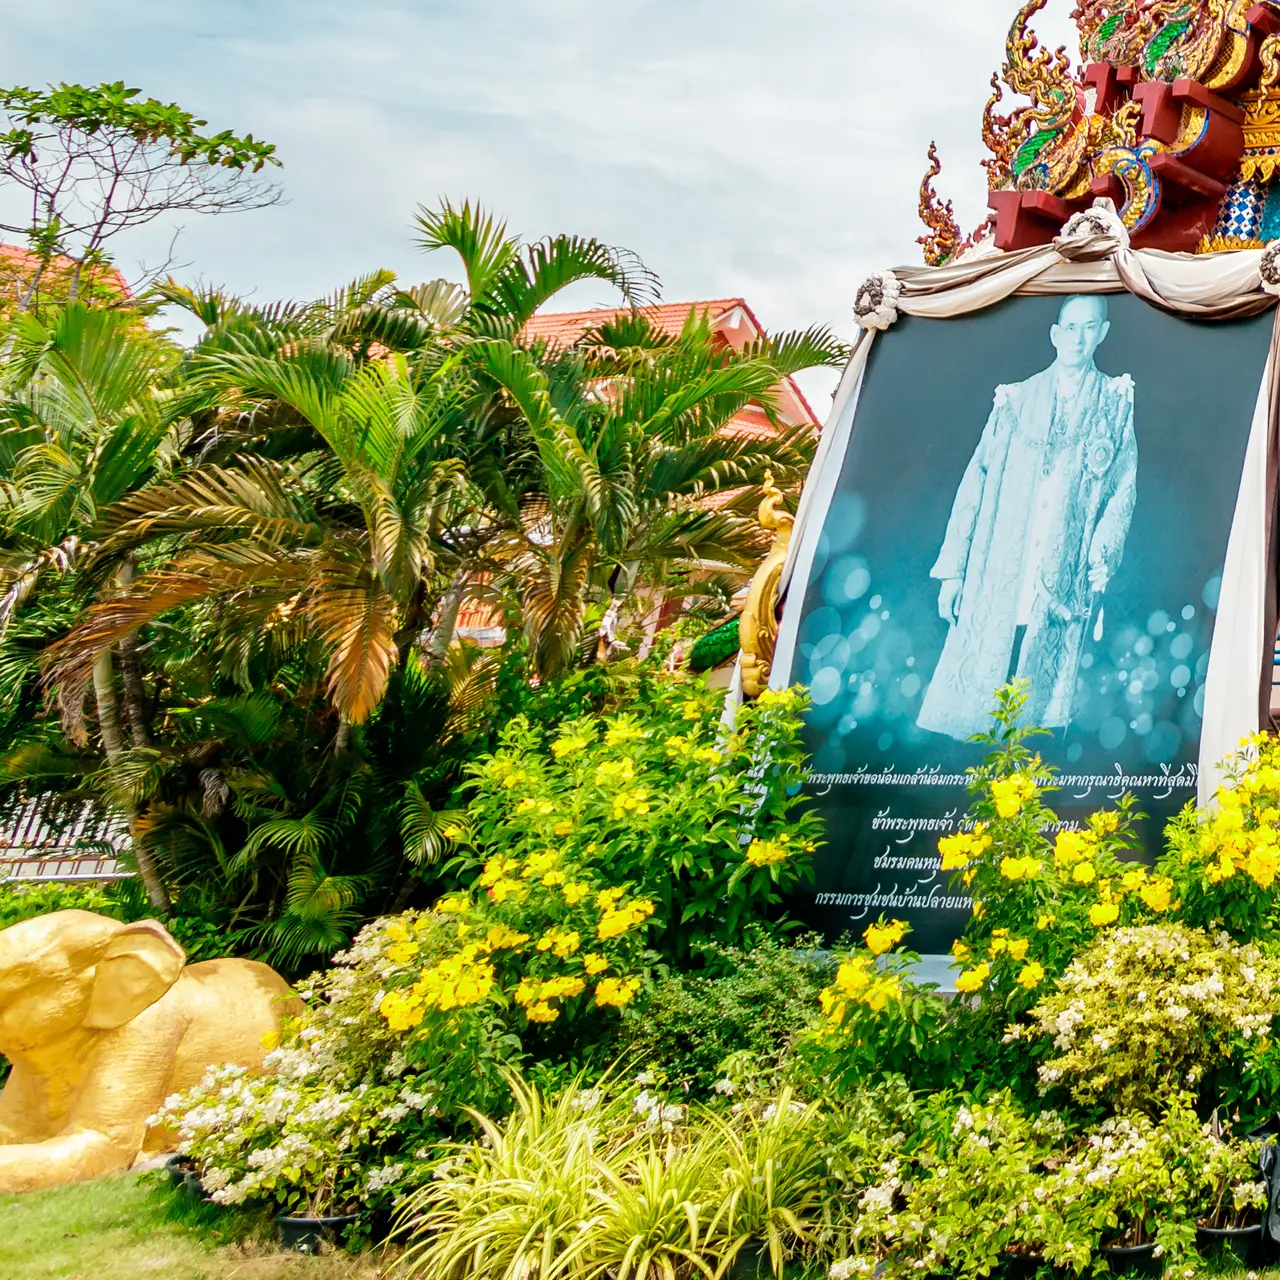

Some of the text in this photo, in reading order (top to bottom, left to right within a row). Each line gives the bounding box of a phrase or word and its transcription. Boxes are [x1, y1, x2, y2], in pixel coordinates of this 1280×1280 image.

[871, 806, 957, 844] ข้าพระพุทธเจ้า
